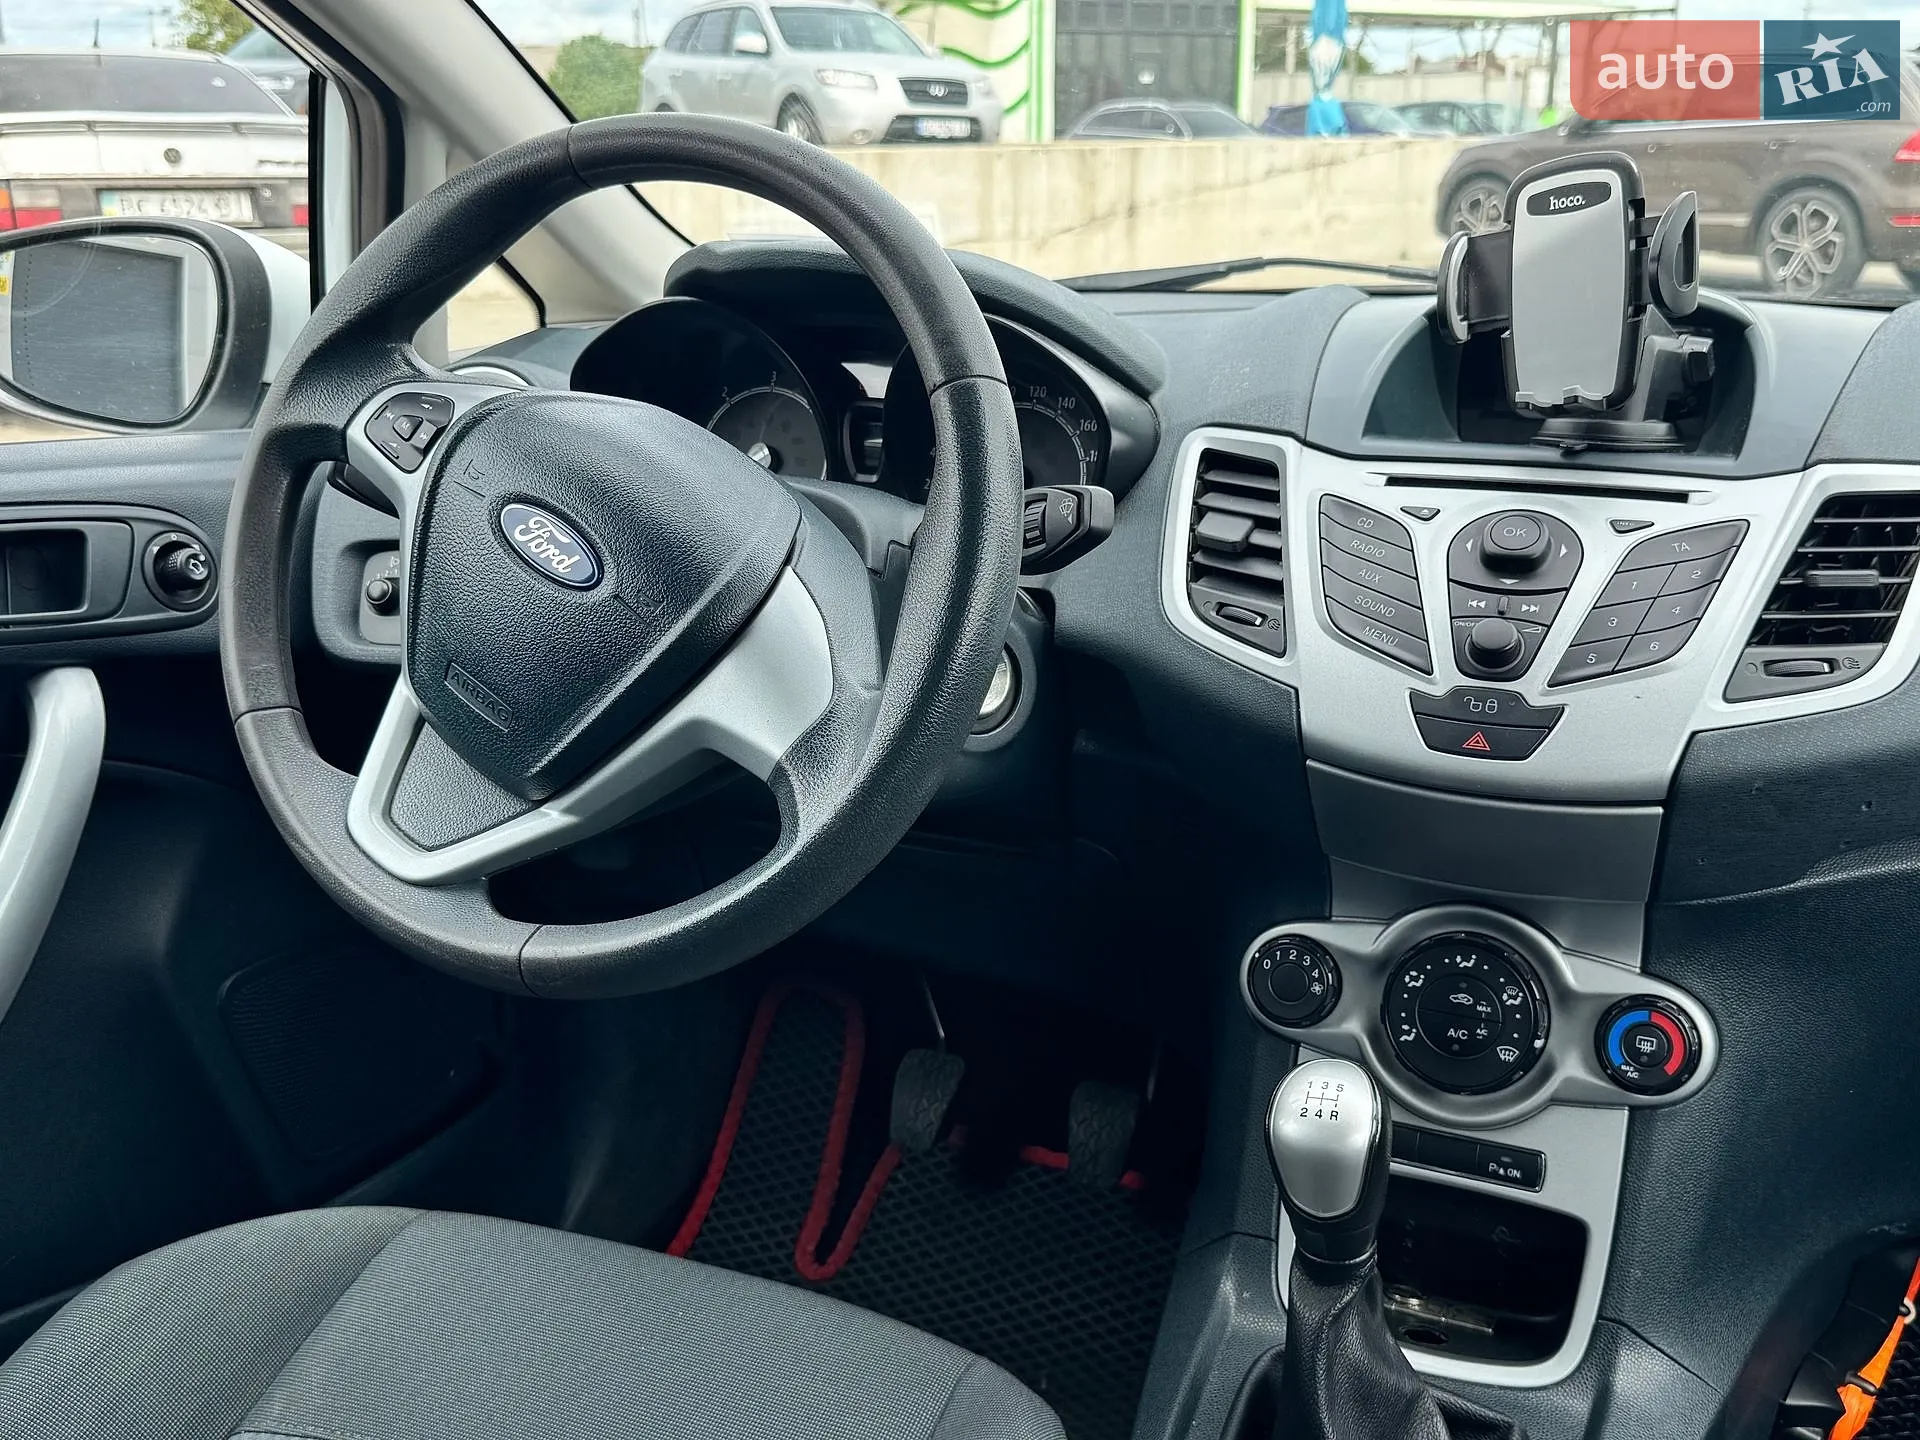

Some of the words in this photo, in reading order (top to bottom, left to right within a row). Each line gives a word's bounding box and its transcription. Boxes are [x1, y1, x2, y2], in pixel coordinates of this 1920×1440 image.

[1549, 194, 1586, 210] hoco.
[1029, 386, 1047, 398] 120
[1057, 397, 1076, 410] 140
[1079, 419, 1098, 432] 160
[1356, 517, 1374, 529] CD
[1503, 527, 1528, 537] OK
[514, 516, 581, 573] Ford
[1350, 539, 1386, 558] RADIO
[1671, 541, 1690, 553] TA
[1359, 568, 1383, 583] AUX
[1630, 581, 1638, 590] 1
[1691, 570, 1702, 579] 2
[1354, 595, 1396, 618] SOUND
[1607, 617, 1618, 627] 3
[1671, 606, 1682, 615] 4
[1362, 625, 1399, 646] MENU
[1586, 653, 1598, 664] 5
[1649, 641, 1661, 651] 6
[1263, 959, 1271, 970] 0
[1275, 950, 1281, 961] 1
[1289, 949, 1297, 960] 2
[1302, 955, 1311, 966] 3
[1311, 968, 1319, 979] 4
[1446, 1028, 1468, 1040] A/C
[1321, 1081, 1329, 1090] 3
[1335, 1083, 1345, 1093] 5
[1299, 1107, 1309, 1118] 2
[1314, 1108, 1323, 1119] 4
[1329, 1110, 1339, 1121] R
[1507, 1168, 1521, 1179] ON
